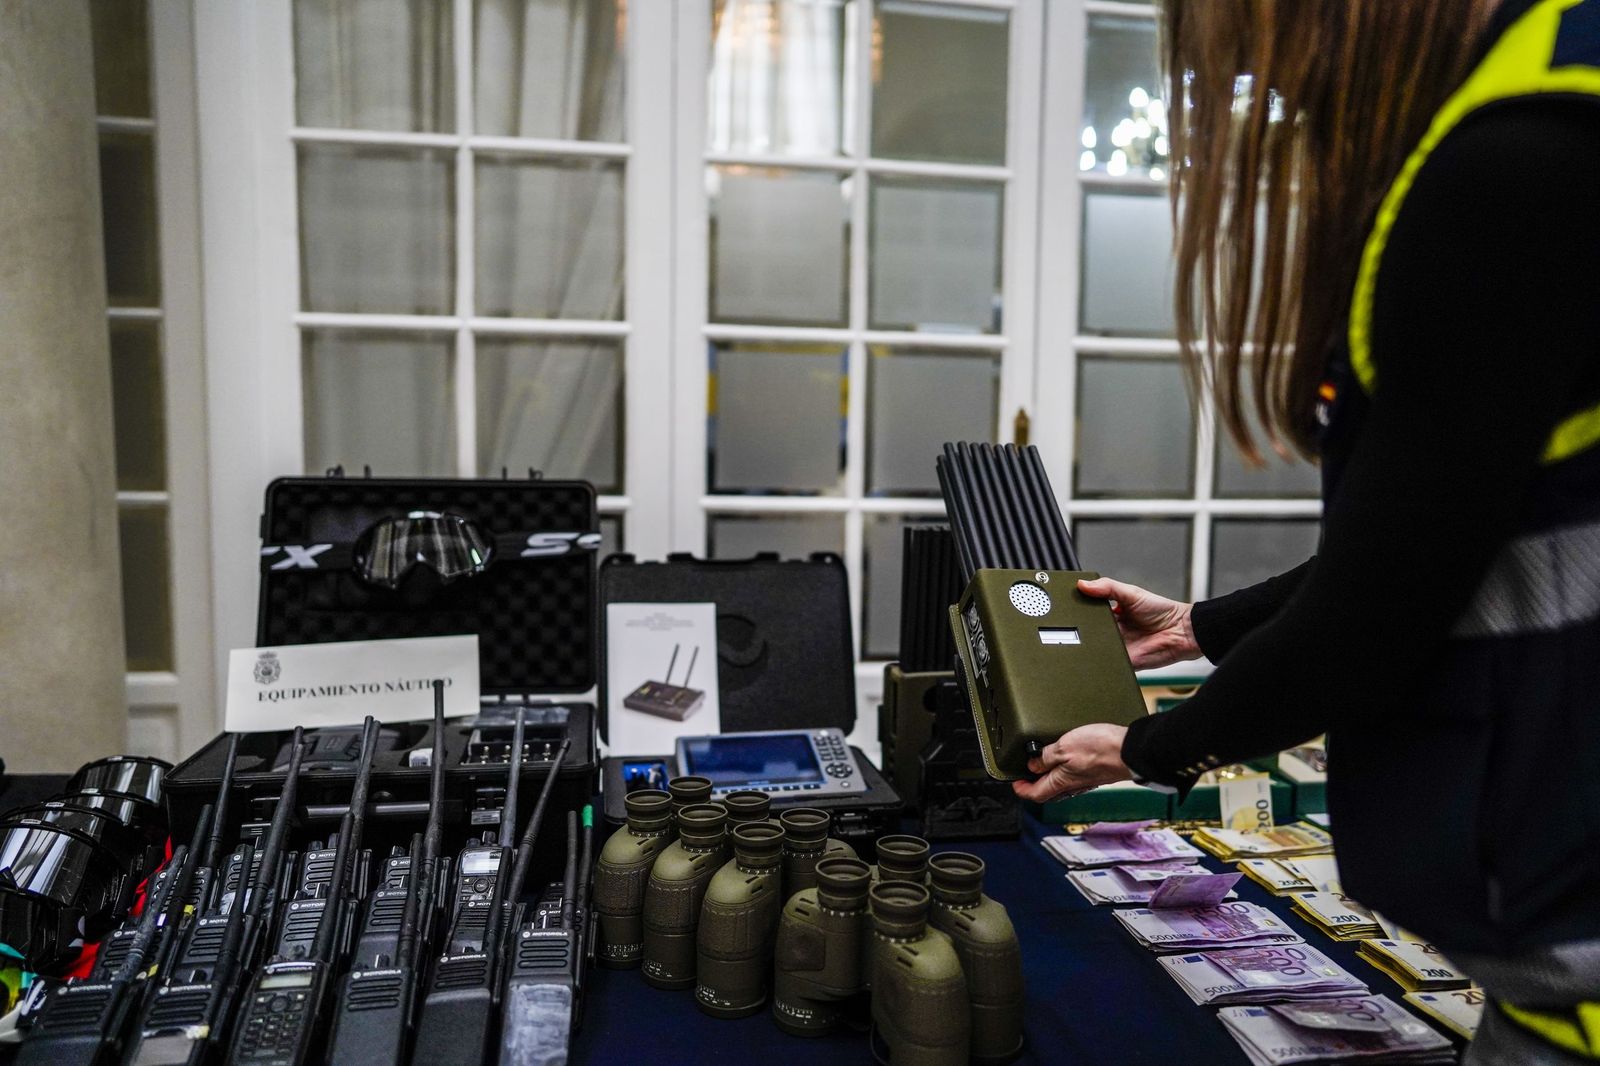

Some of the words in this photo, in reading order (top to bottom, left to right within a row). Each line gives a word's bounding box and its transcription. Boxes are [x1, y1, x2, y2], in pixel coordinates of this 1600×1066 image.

[257, 681, 381, 703] EQUIPAMIENTO
[385, 674, 453, 692] NÁUTIO
[1331, 915, 1361, 923] 200
[362, 969, 402, 977] MOTOROLA
[1420, 968, 1454, 978] 200
[170, 984, 212, 992] MOTOROLA
[1203, 984, 1231, 997] 500
